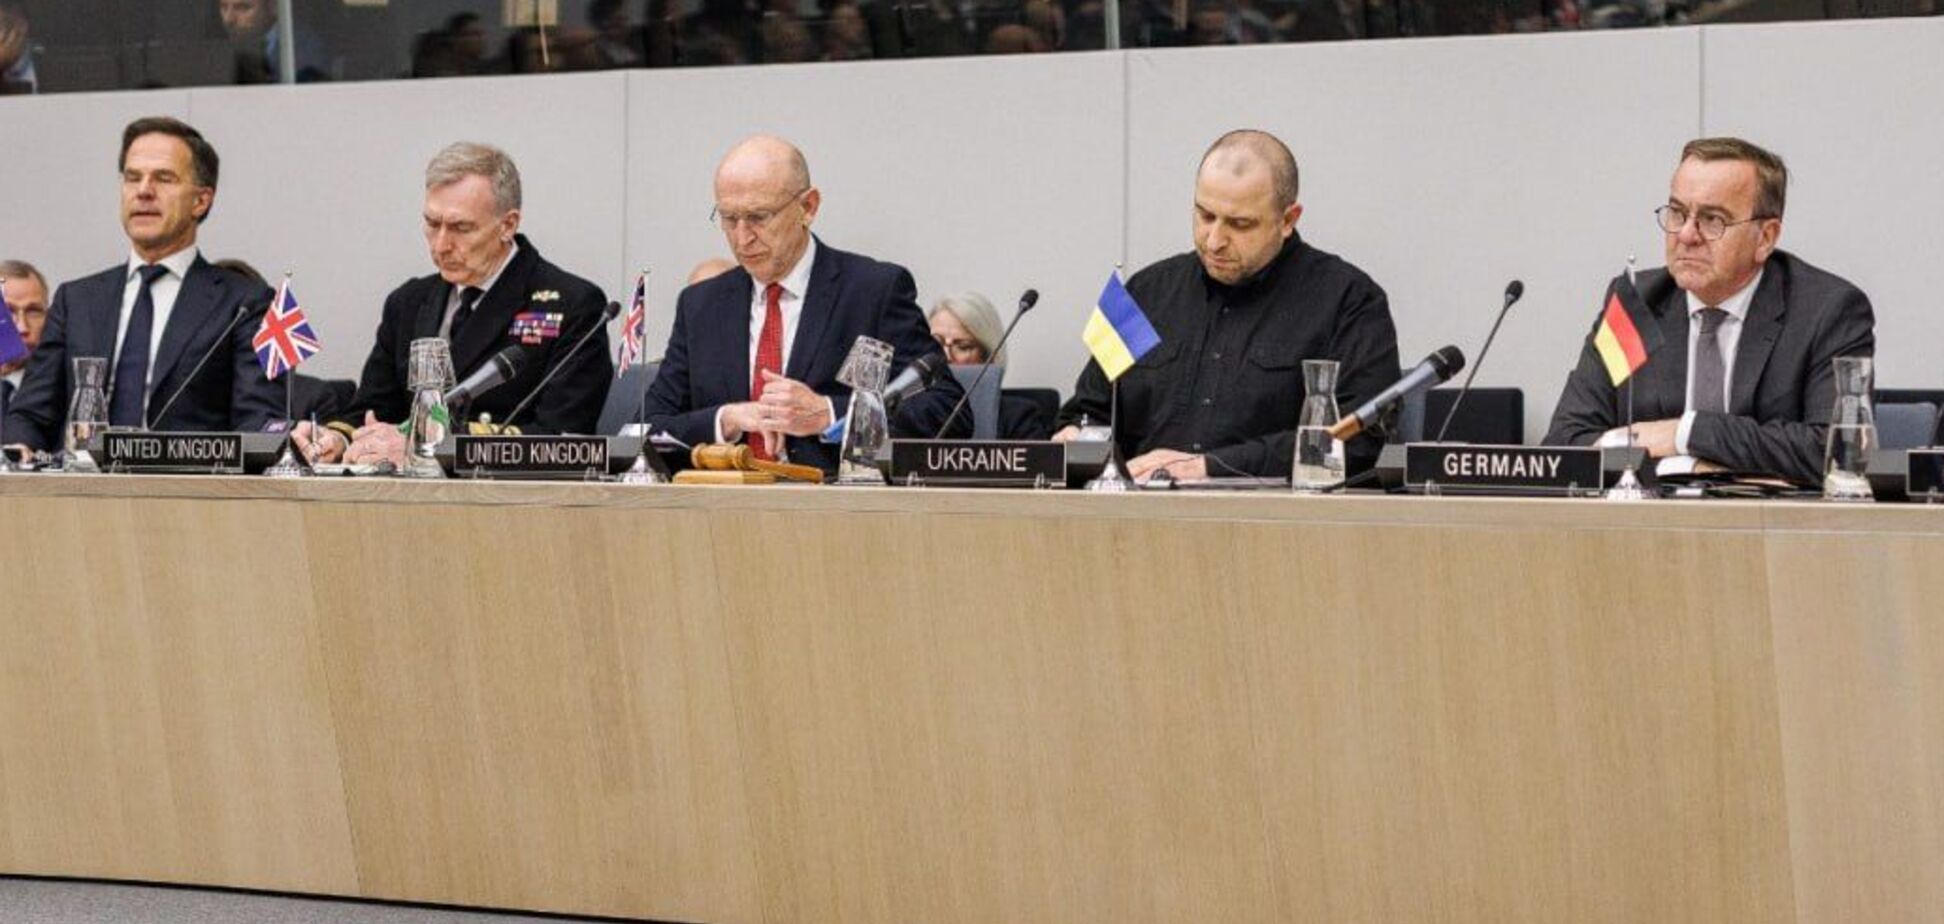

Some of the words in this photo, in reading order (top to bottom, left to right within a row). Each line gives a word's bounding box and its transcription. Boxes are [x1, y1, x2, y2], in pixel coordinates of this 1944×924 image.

[110, 438, 160, 458] UNITED
[167, 439, 236, 459] KINGDOM
[465, 442, 523, 463] UNITED
[530, 443, 604, 464] KINGDOM
[927, 447, 1027, 472] UKRAINE
[1443, 452, 1562, 477] GERMANY
